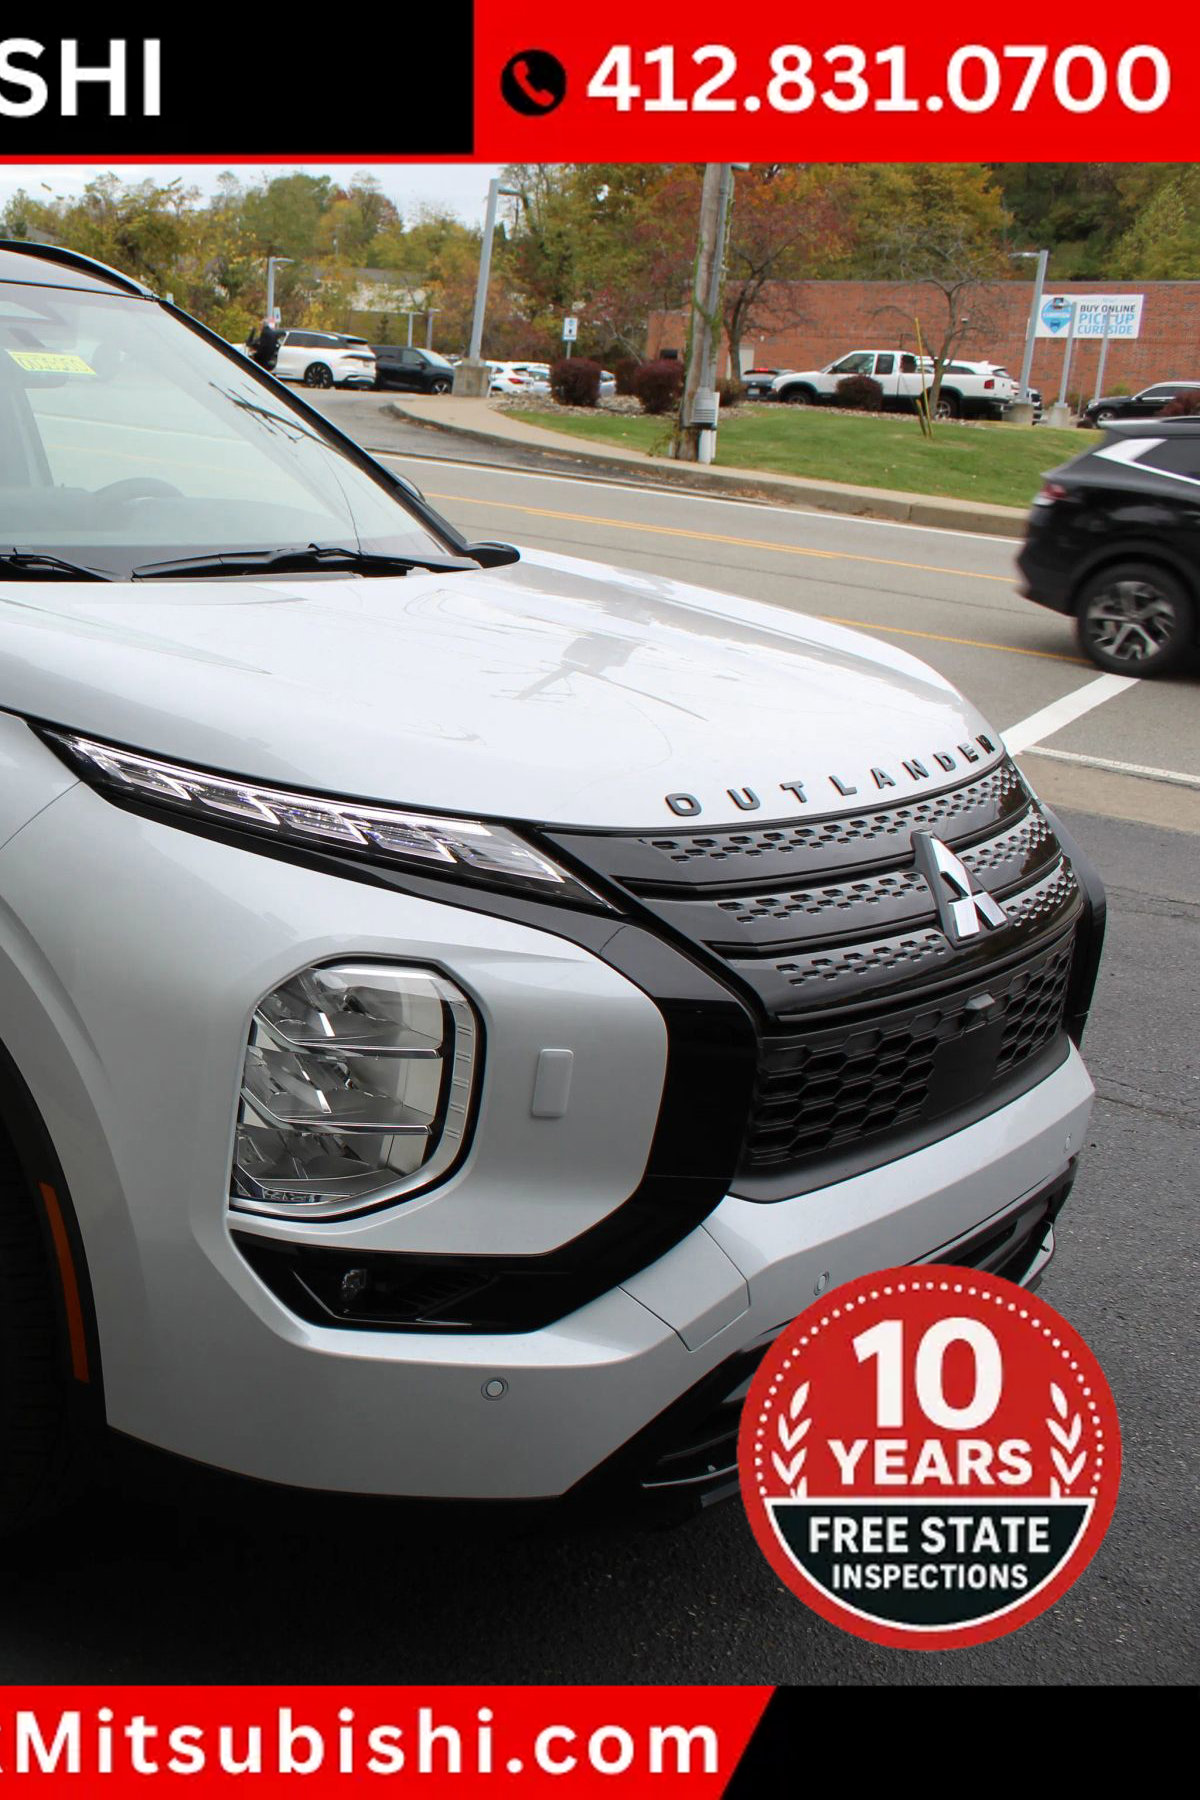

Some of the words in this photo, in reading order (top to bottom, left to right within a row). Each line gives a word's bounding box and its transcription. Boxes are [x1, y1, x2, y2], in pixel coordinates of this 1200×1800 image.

[1080, 304, 1099, 312] BUY
[1101, 304, 1136, 312] ONLINE
[665, 734, 996, 817] OUTLANDER
